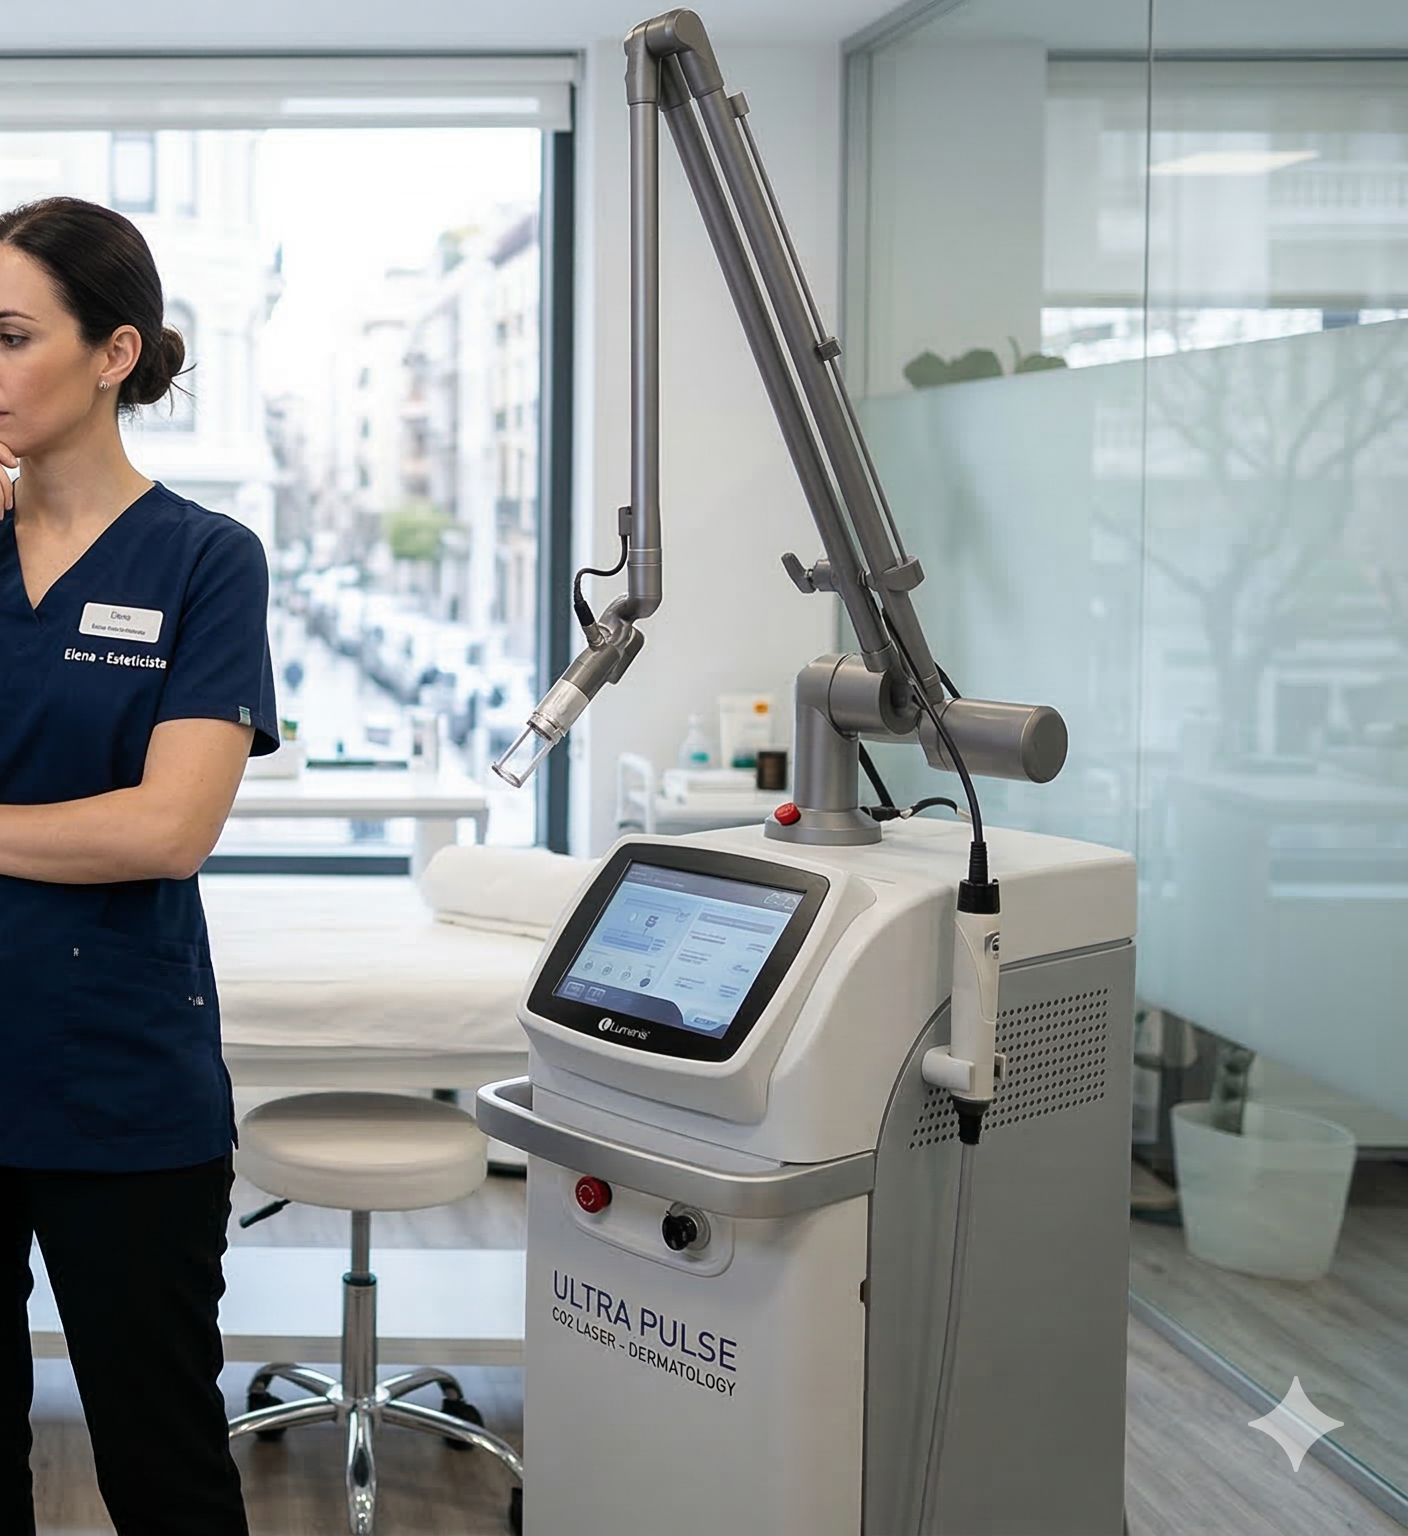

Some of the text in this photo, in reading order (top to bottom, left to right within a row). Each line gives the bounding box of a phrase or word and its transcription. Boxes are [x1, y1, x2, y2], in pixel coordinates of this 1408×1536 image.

[64, 647, 97, 663] Elena
[552, 1269, 737, 1373] ULTRA PULSE
[552, 1306, 574, 1330] CO2
[576, 1317, 616, 1350] LASER
[628, 1341, 737, 1398] DERMATOLOGY
